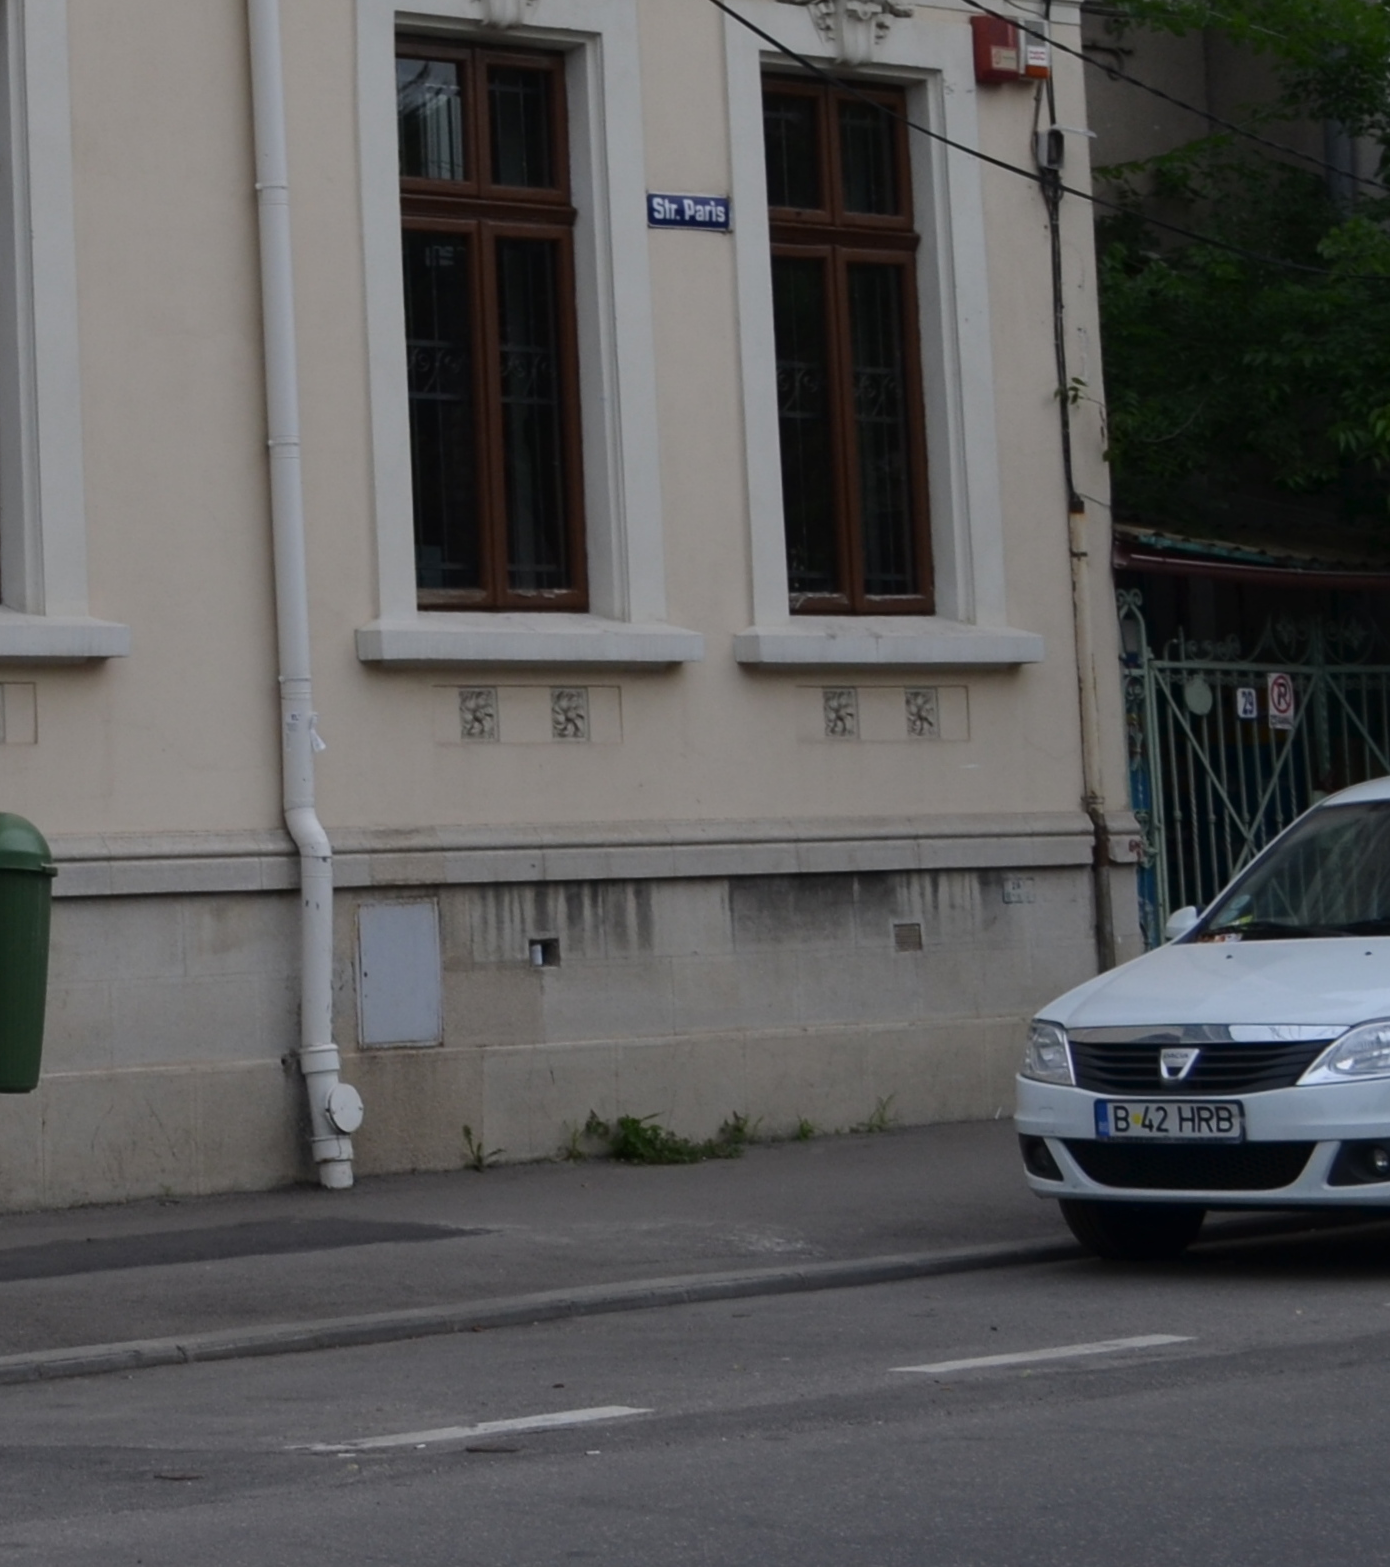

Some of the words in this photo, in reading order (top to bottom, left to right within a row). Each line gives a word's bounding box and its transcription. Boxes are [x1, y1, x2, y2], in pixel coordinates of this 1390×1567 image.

[652, 197, 681, 219] Str.
[683, 199, 726, 222] Paris
[1241, 690, 1254, 715] 29
[1113, 1105, 1130, 1132] B
[1141, 1105, 1169, 1133] 42
[1177, 1106, 1234, 1133] HRB
